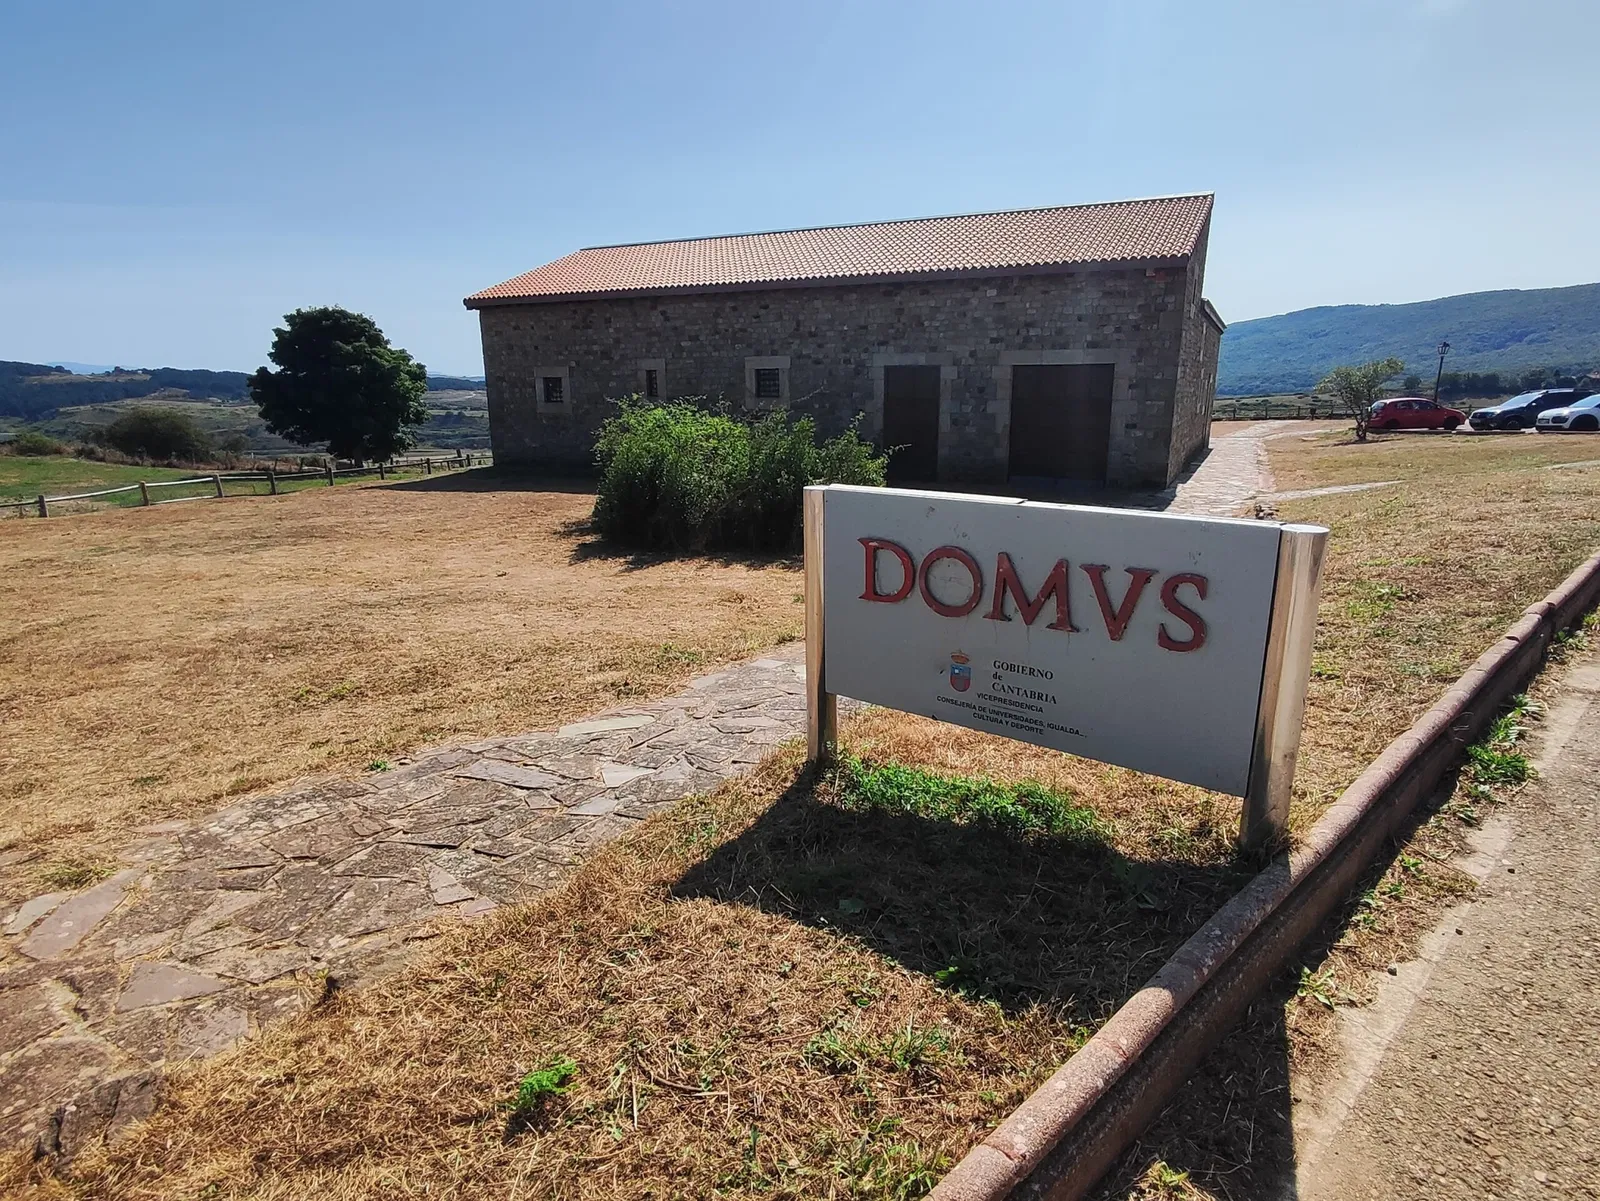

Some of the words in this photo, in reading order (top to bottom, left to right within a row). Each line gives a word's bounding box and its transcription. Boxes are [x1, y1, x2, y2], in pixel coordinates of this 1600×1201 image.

[857, 537, 1208, 652] DOMVS
[992, 672, 1003, 681] de
[993, 660, 1053, 680] GOBIERNO
[976, 692, 1044, 713] VICEPRESIDENCIA
[991, 682, 1057, 704] CANTABRIA
[936, 695, 977, 711] CONSEJERÍA
[978, 705, 987, 714] DE
[988, 708, 1046, 727] UNIVERSIDADES,
[972, 712, 1003, 725] CULTURA
[1010, 721, 1044, 735] DEPORTE
